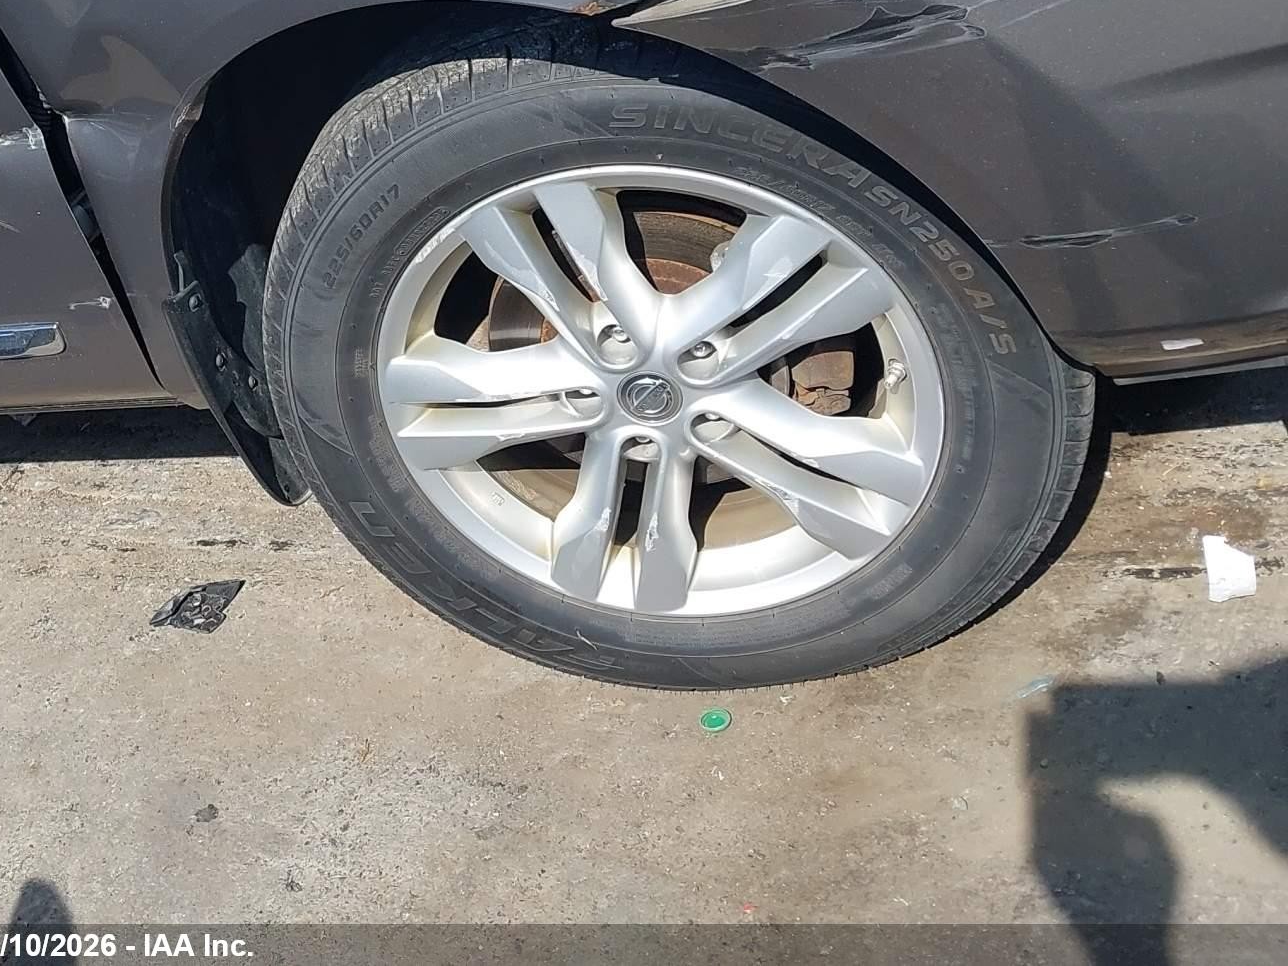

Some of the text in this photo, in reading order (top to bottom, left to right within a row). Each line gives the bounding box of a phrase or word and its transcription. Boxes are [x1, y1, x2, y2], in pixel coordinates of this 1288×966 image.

[321, 183, 401, 289] 225/60R17
[863, 185, 976, 281] SN250
[963, 286, 1017, 355] A/S
